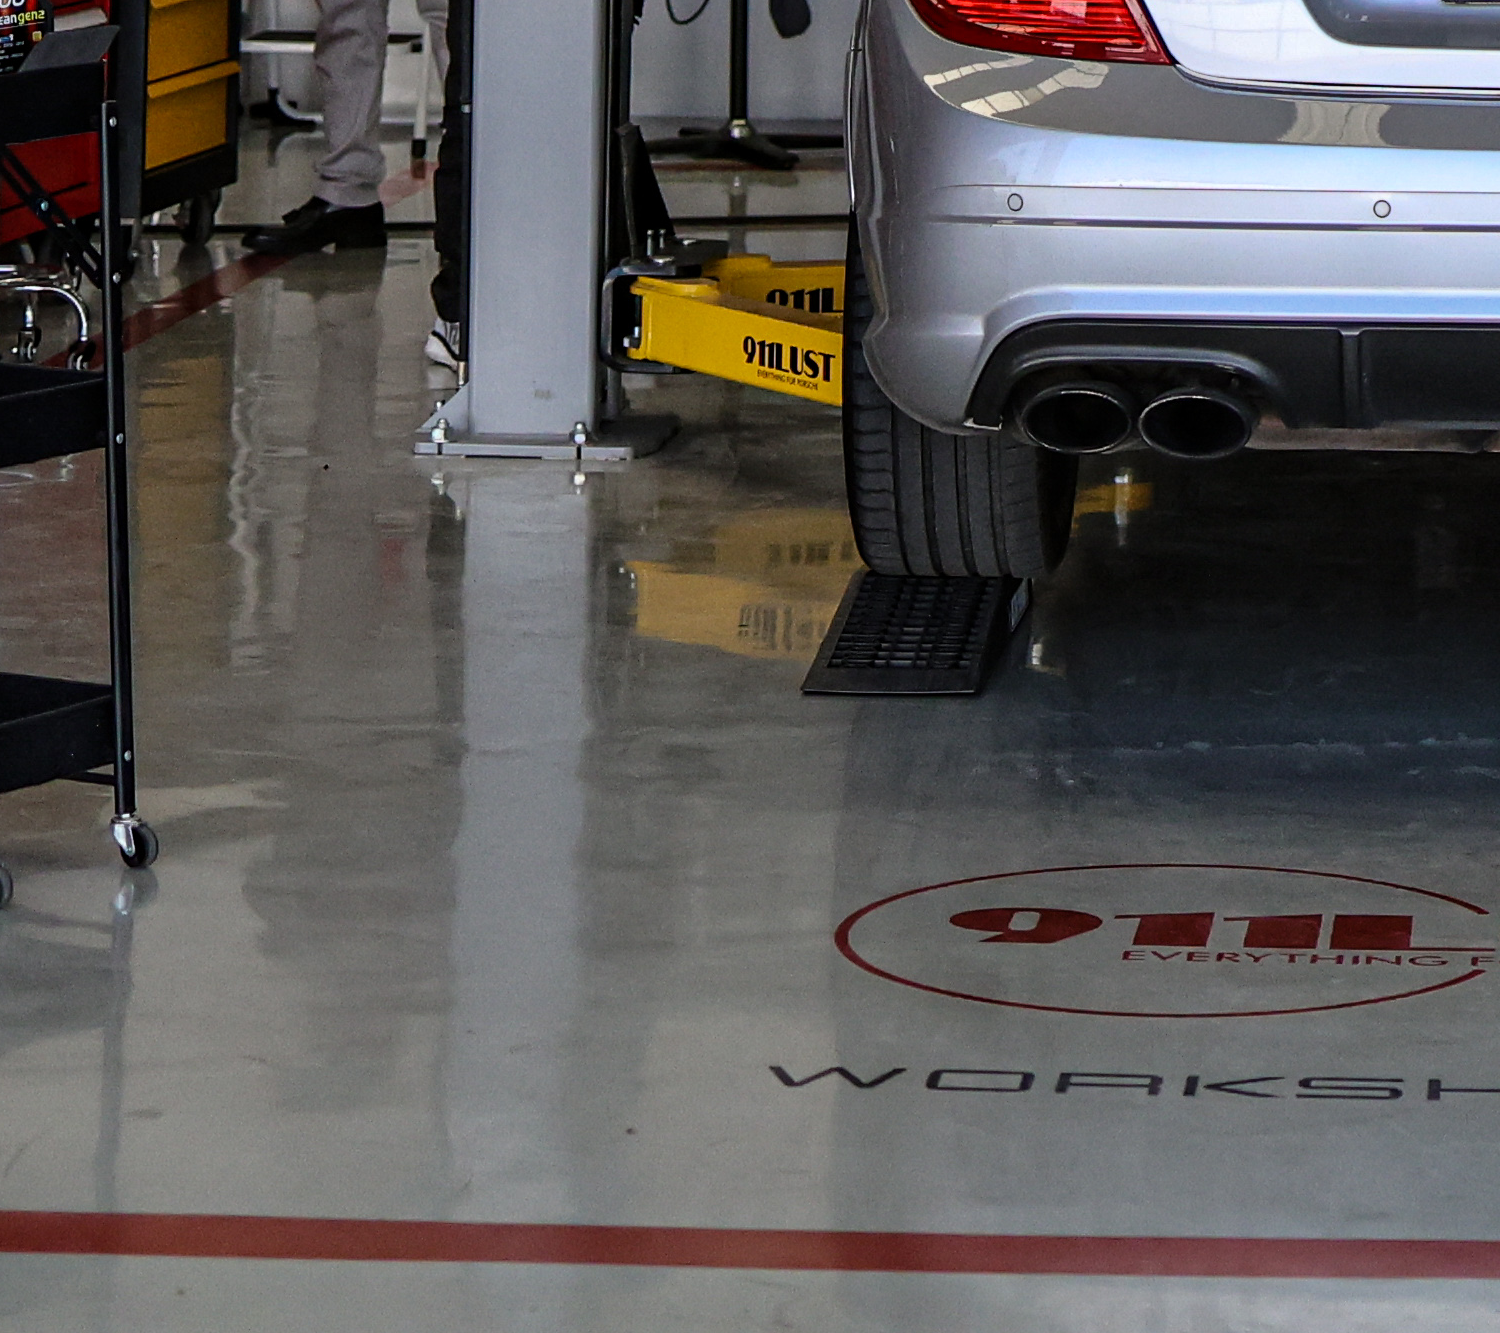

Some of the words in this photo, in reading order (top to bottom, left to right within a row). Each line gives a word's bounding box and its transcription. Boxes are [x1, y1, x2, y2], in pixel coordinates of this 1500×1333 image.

[17, 10, 45, 26] gen2
[743, 336, 836, 382] 911LUST
[1121, 950, 1449, 968] EVERYTHING
